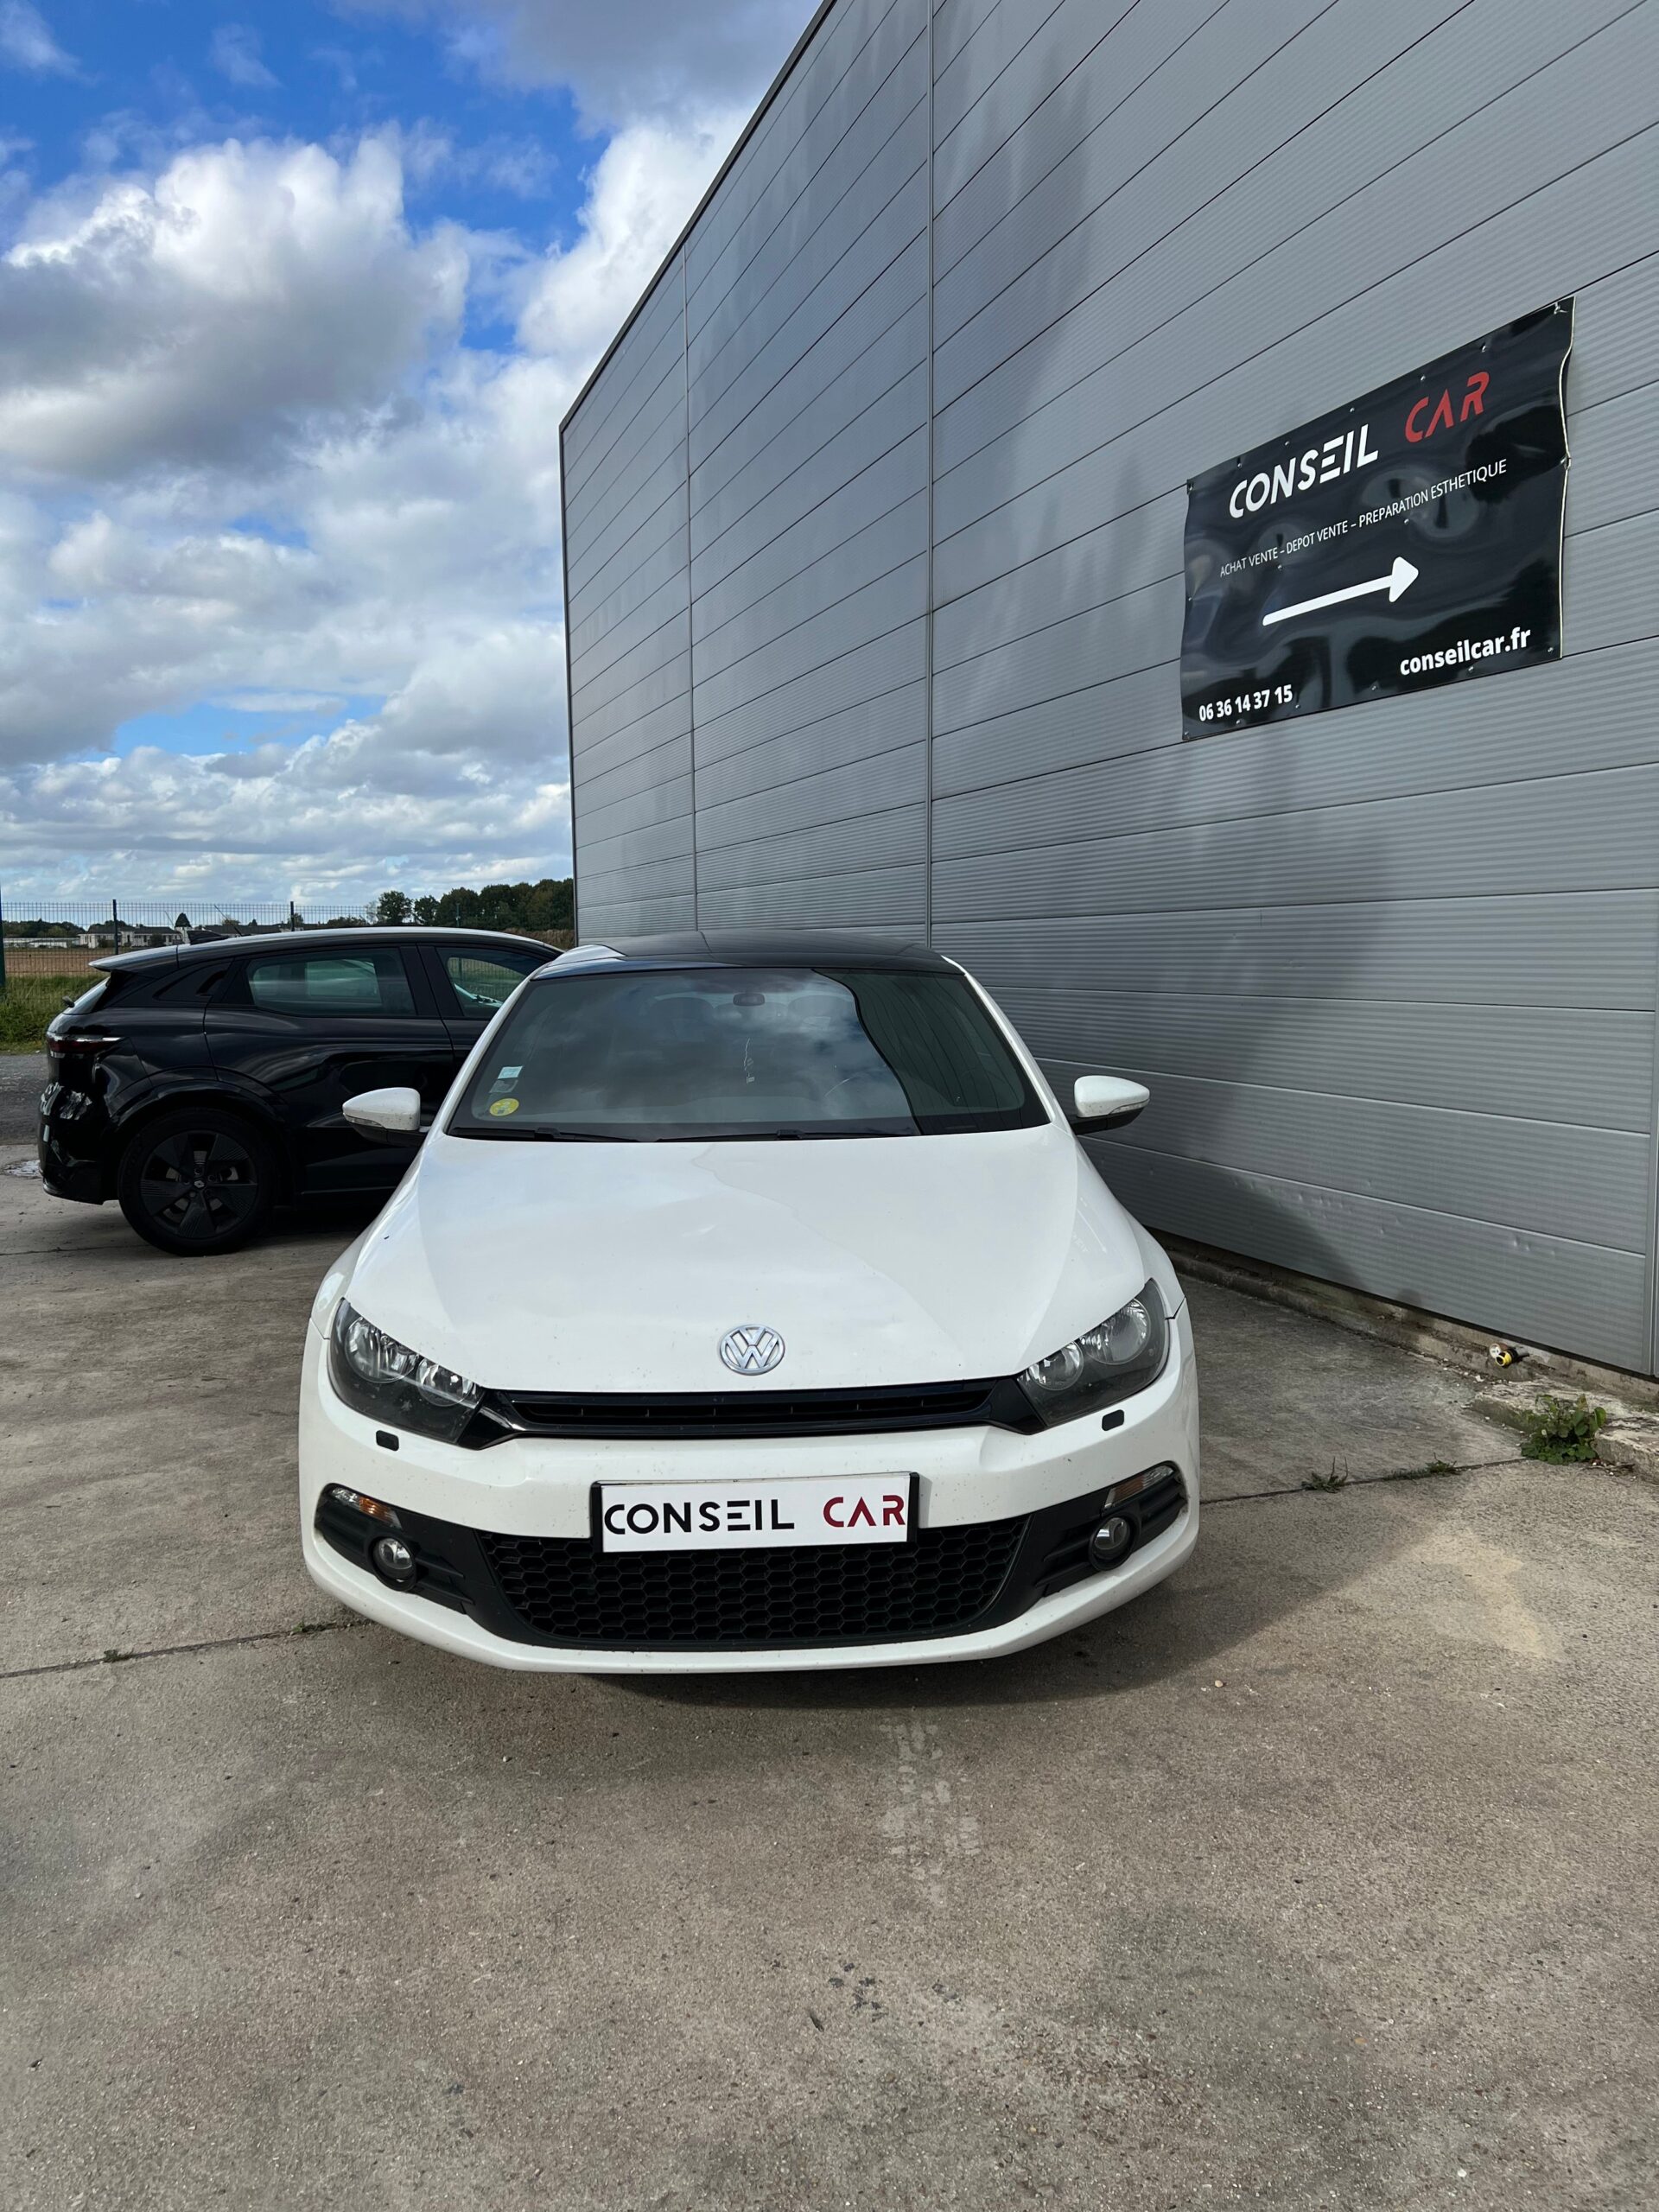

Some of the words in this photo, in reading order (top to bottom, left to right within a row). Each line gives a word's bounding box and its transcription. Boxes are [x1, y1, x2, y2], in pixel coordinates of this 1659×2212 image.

[1229, 423, 1379, 518] CONSEIL
[1404, 371, 1490, 443] CAR
[1219, 557, 1248, 578] ACHAT
[1248, 547, 1279, 567] VENTE
[1286, 532, 1315, 555] DEPOT
[1316, 520, 1349, 543] VENTE
[1358, 488, 1428, 528] PREPARATION
[1430, 458, 1507, 500] ESTHETIQUE
[1400, 626, 1531, 676] conseilcar.fr
[1198, 702, 1214, 721] 06
[1216, 698, 1232, 718] 36
[1235, 694, 1251, 713] 14
[1253, 689, 1270, 709] 37
[1274, 683, 1293, 704] 15
[604, 1499, 795, 1535] CONSEIL
[823, 1495, 906, 1528] CAR
